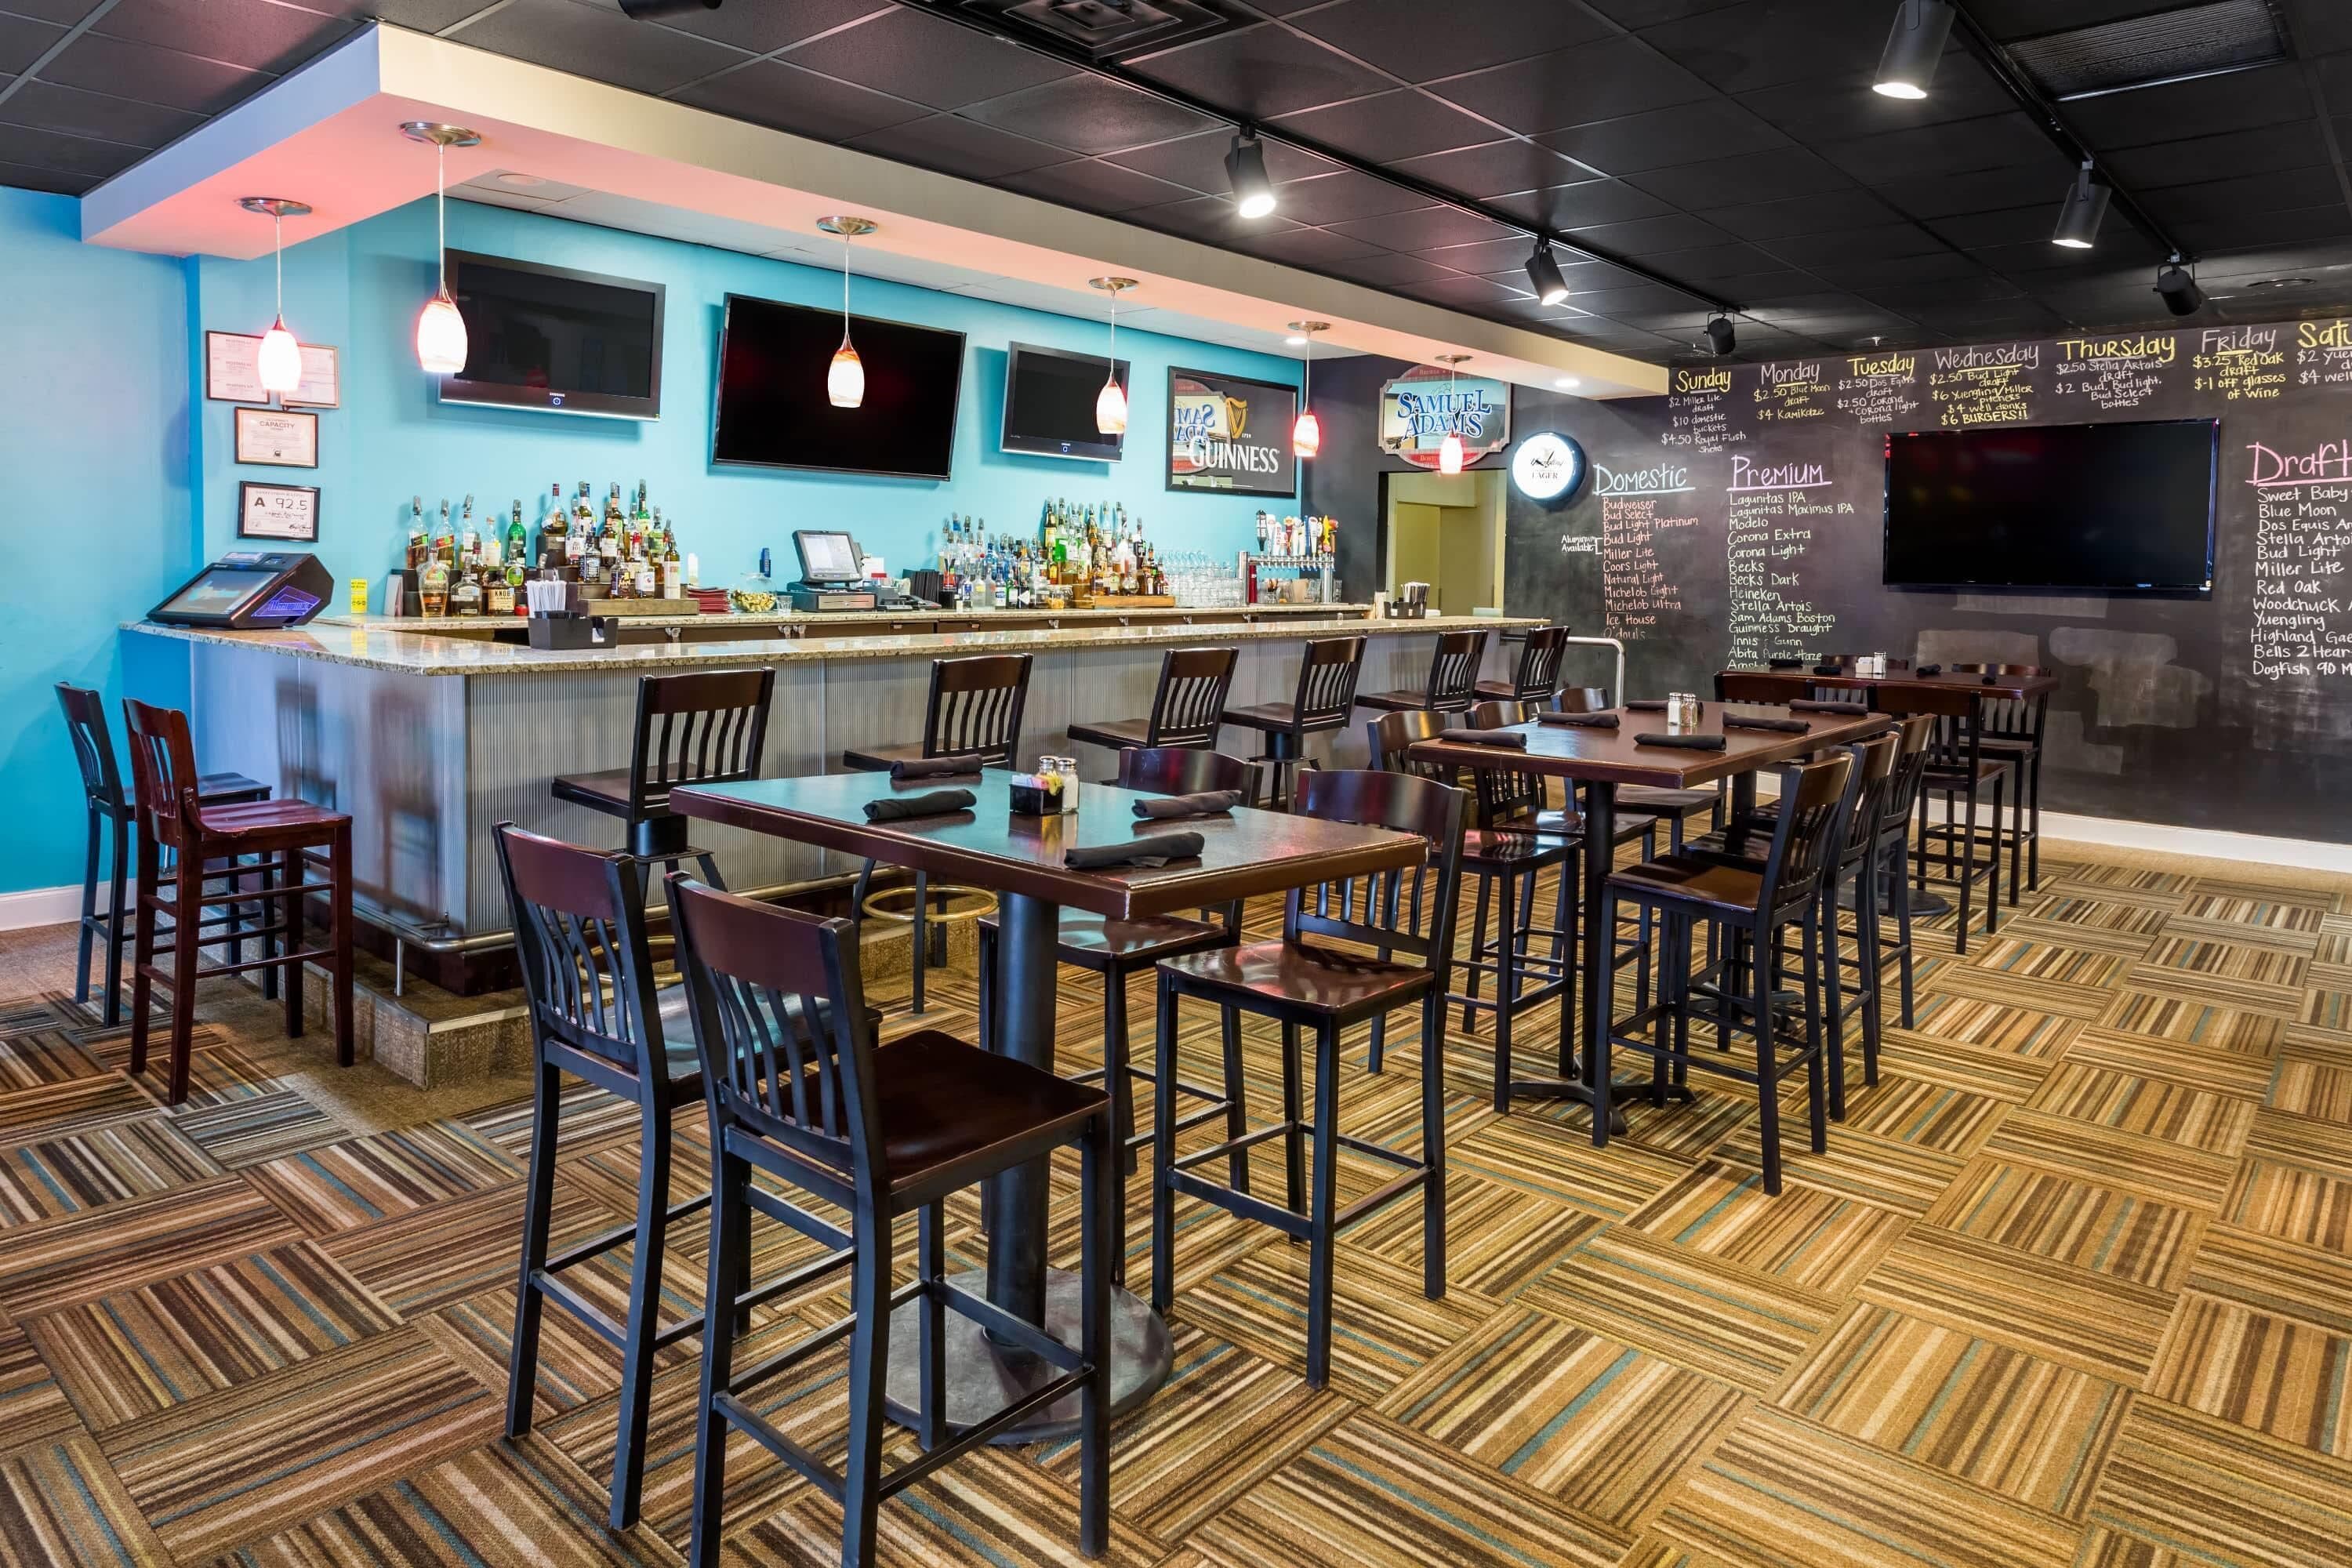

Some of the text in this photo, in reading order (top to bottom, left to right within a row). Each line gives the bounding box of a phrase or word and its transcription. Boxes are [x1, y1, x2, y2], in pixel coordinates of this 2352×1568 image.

[2201, 327, 2276, 354] Friday
[1935, 344, 2038, 369] Wednesday
[2056, 336, 2175, 363] Thursday
[2296, 349, 2319, 365] $2
[1847, 354, 1915, 379] Tuesday
[2193, 352, 2284, 368] $3.25 Red Oak
[1762, 362, 1820, 384] Monday
[2056, 362, 2085, 376] $2.50
[2089, 361, 2118, 371] Stella
[1675, 367, 1731, 392] Sunday
[1838, 379, 1867, 390] $2.50
[1870, 378, 1887, 388] Dos
[1929, 369, 2020, 386] $2.50 Bud Light
[2218, 378, 2238, 387] off
[2243, 373, 2286, 390] glasses
[2299, 369, 2321, 384] $4
[1754, 389, 1787, 402] $2.50
[1791, 386, 1807, 395] Blue
[2056, 383, 2076, 394] $2
[2113, 379, 2133, 390] Bud
[2091, 387, 2153, 401] Bud Select
[1932, 390, 1948, 401] $6
[2227, 389, 2241, 400] of
[1397, 389, 1492, 418] SAMUEL
[1668, 397, 1680, 408] $2
[1838, 397, 1867, 409] $2.50
[1947, 404, 1965, 413] $4
[1969, 404, 1991, 412] well
[2101, 398, 2139, 408] bottles
[1673, 416, 1689, 427] $10
[1757, 409, 1773, 420] $4
[1860, 414, 1892, 424] bottles
[1941, 409, 2027, 425] $6 BURGERS!!
[1403, 413, 1483, 440] ADAMS
[1693, 424, 1726, 434] buckets
[1661, 431, 1746, 446] $4.50 Royal Flush
[1189, 437, 1279, 474] GUINNESS
[2245, 439, 2352, 486] Draft
[1592, 463, 1686, 495] Domestic
[1731, 455, 1824, 488] Premium
[1730, 492, 1806, 506] Lagunitas IPA
[2258, 486, 2347, 503] Sweet Baby
[255, 497, 307, 510] A 92.5
[1602, 497, 1657, 510] Budweiser
[1730, 503, 1854, 518] Lagunitas Maximus IPA
[2259, 503, 2336, 518] Blue Moon
[1602, 510, 1653, 521] Bud Select
[1602, 517, 1698, 532] Bud Light Platinum
[1730, 517, 1768, 531] Modelo
[2259, 519, 2329, 532] Dos Equis
[1603, 532, 1653, 546] Bud Light
[1728, 528, 1811, 545] Corona Extra
[2256, 532, 2304, 546] Stella
[1603, 548, 1654, 560] Miller Lite
[1728, 544, 1806, 560] Corona Light
[2258, 546, 2340, 561] Bud Light
[1603, 560, 1659, 572] Coors Light
[1729, 560, 1764, 573] Becks
[2256, 561, 2345, 577] Miller Lite
[1604, 572, 1664, 587] Natural Light
[1730, 572, 1799, 586] Becks Dark
[1605, 584, 1678, 598] Michelob Light
[1730, 586, 1780, 601] Heineken
[2257, 579, 2321, 595] Red Oak
[1606, 599, 1649, 612] Michelob
[1731, 599, 1812, 612] Stella Artois
[2253, 597, 2341, 613] Woodchuck
[1606, 613, 1656, 625] Ice House
[1730, 611, 1835, 623] Sam Adams Boston
[2254, 610, 2325, 631] Yuengling
[1729, 622, 1832, 636] Guinness Draught
[2251, 627, 2316, 645] Highland
[1733, 634, 1802, 646] Innis Gunn
[1728, 646, 1759, 659] Abita
[1795, 649, 1822, 660] Haze
[2254, 644, 2352, 659] Bells 2 Hear
[2253, 661, 2336, 680] Dogfish 90
